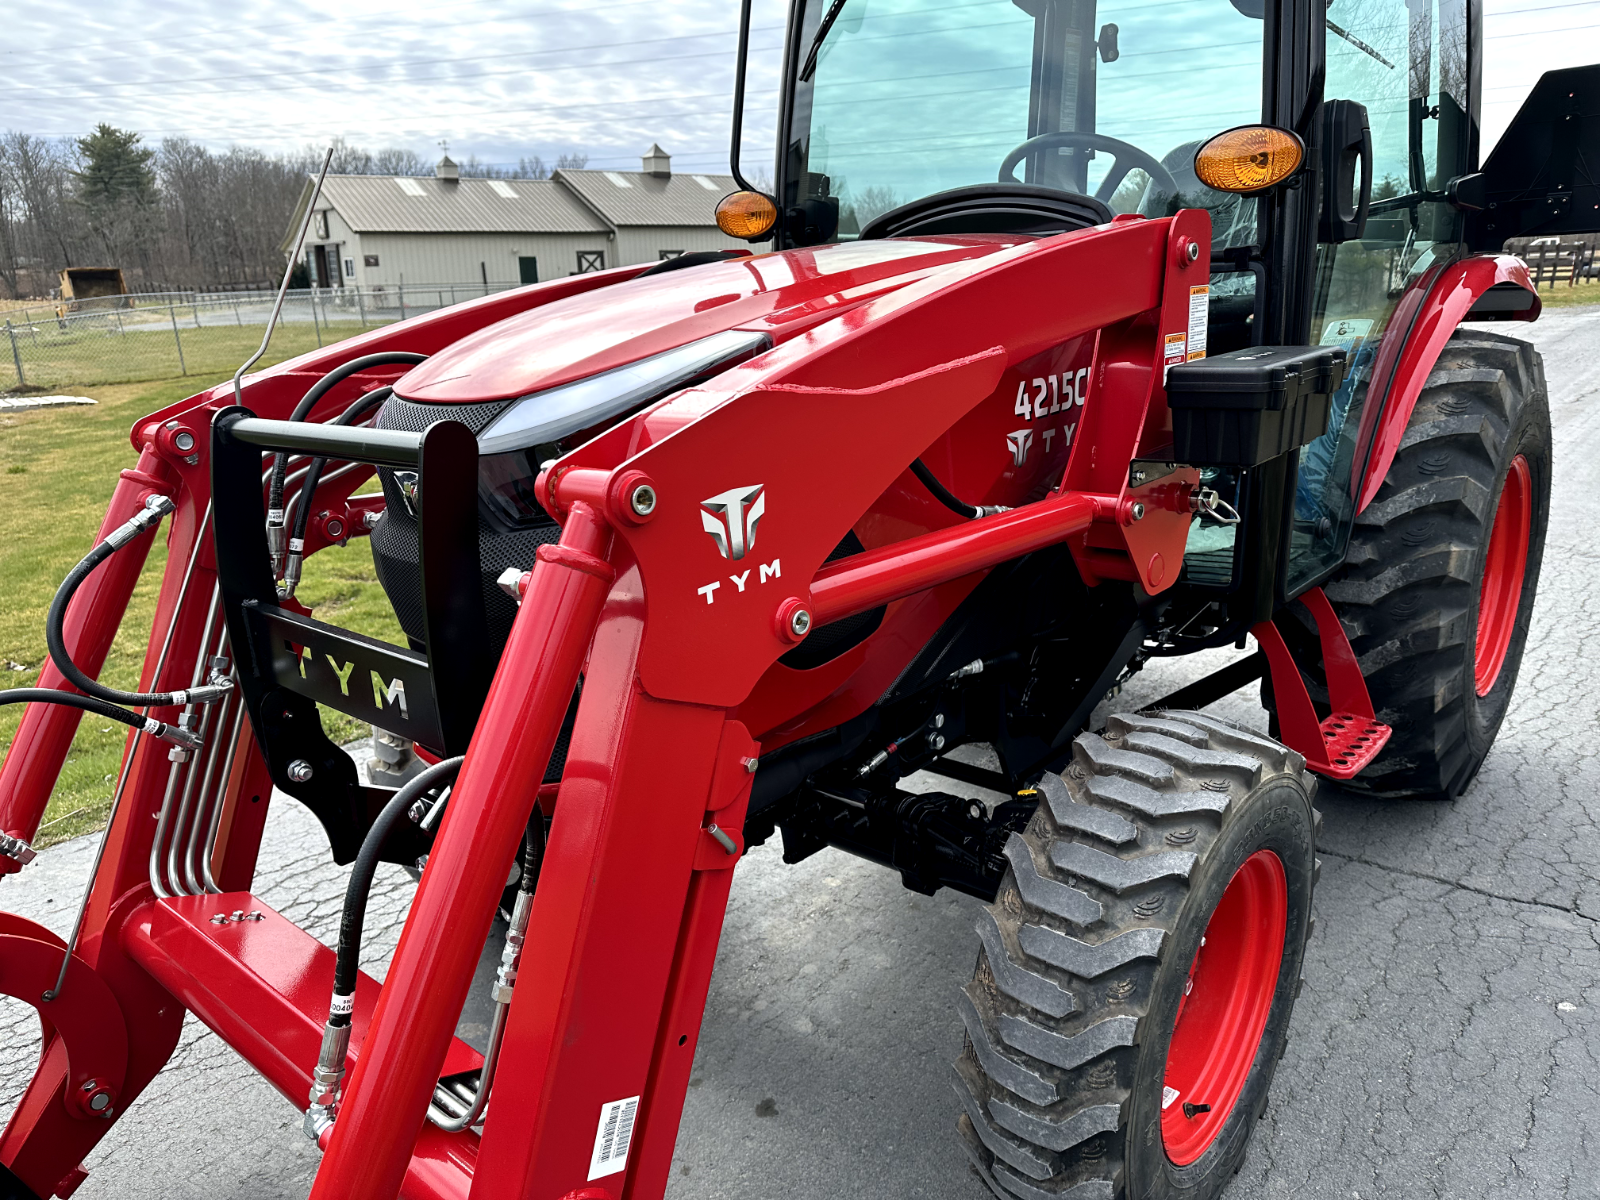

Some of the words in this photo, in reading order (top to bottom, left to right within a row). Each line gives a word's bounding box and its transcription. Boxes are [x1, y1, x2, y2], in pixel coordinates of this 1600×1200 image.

[1042, 422, 1076, 453] TY
[697, 558, 782, 605] TYM
[284, 639, 409, 720] TYM
